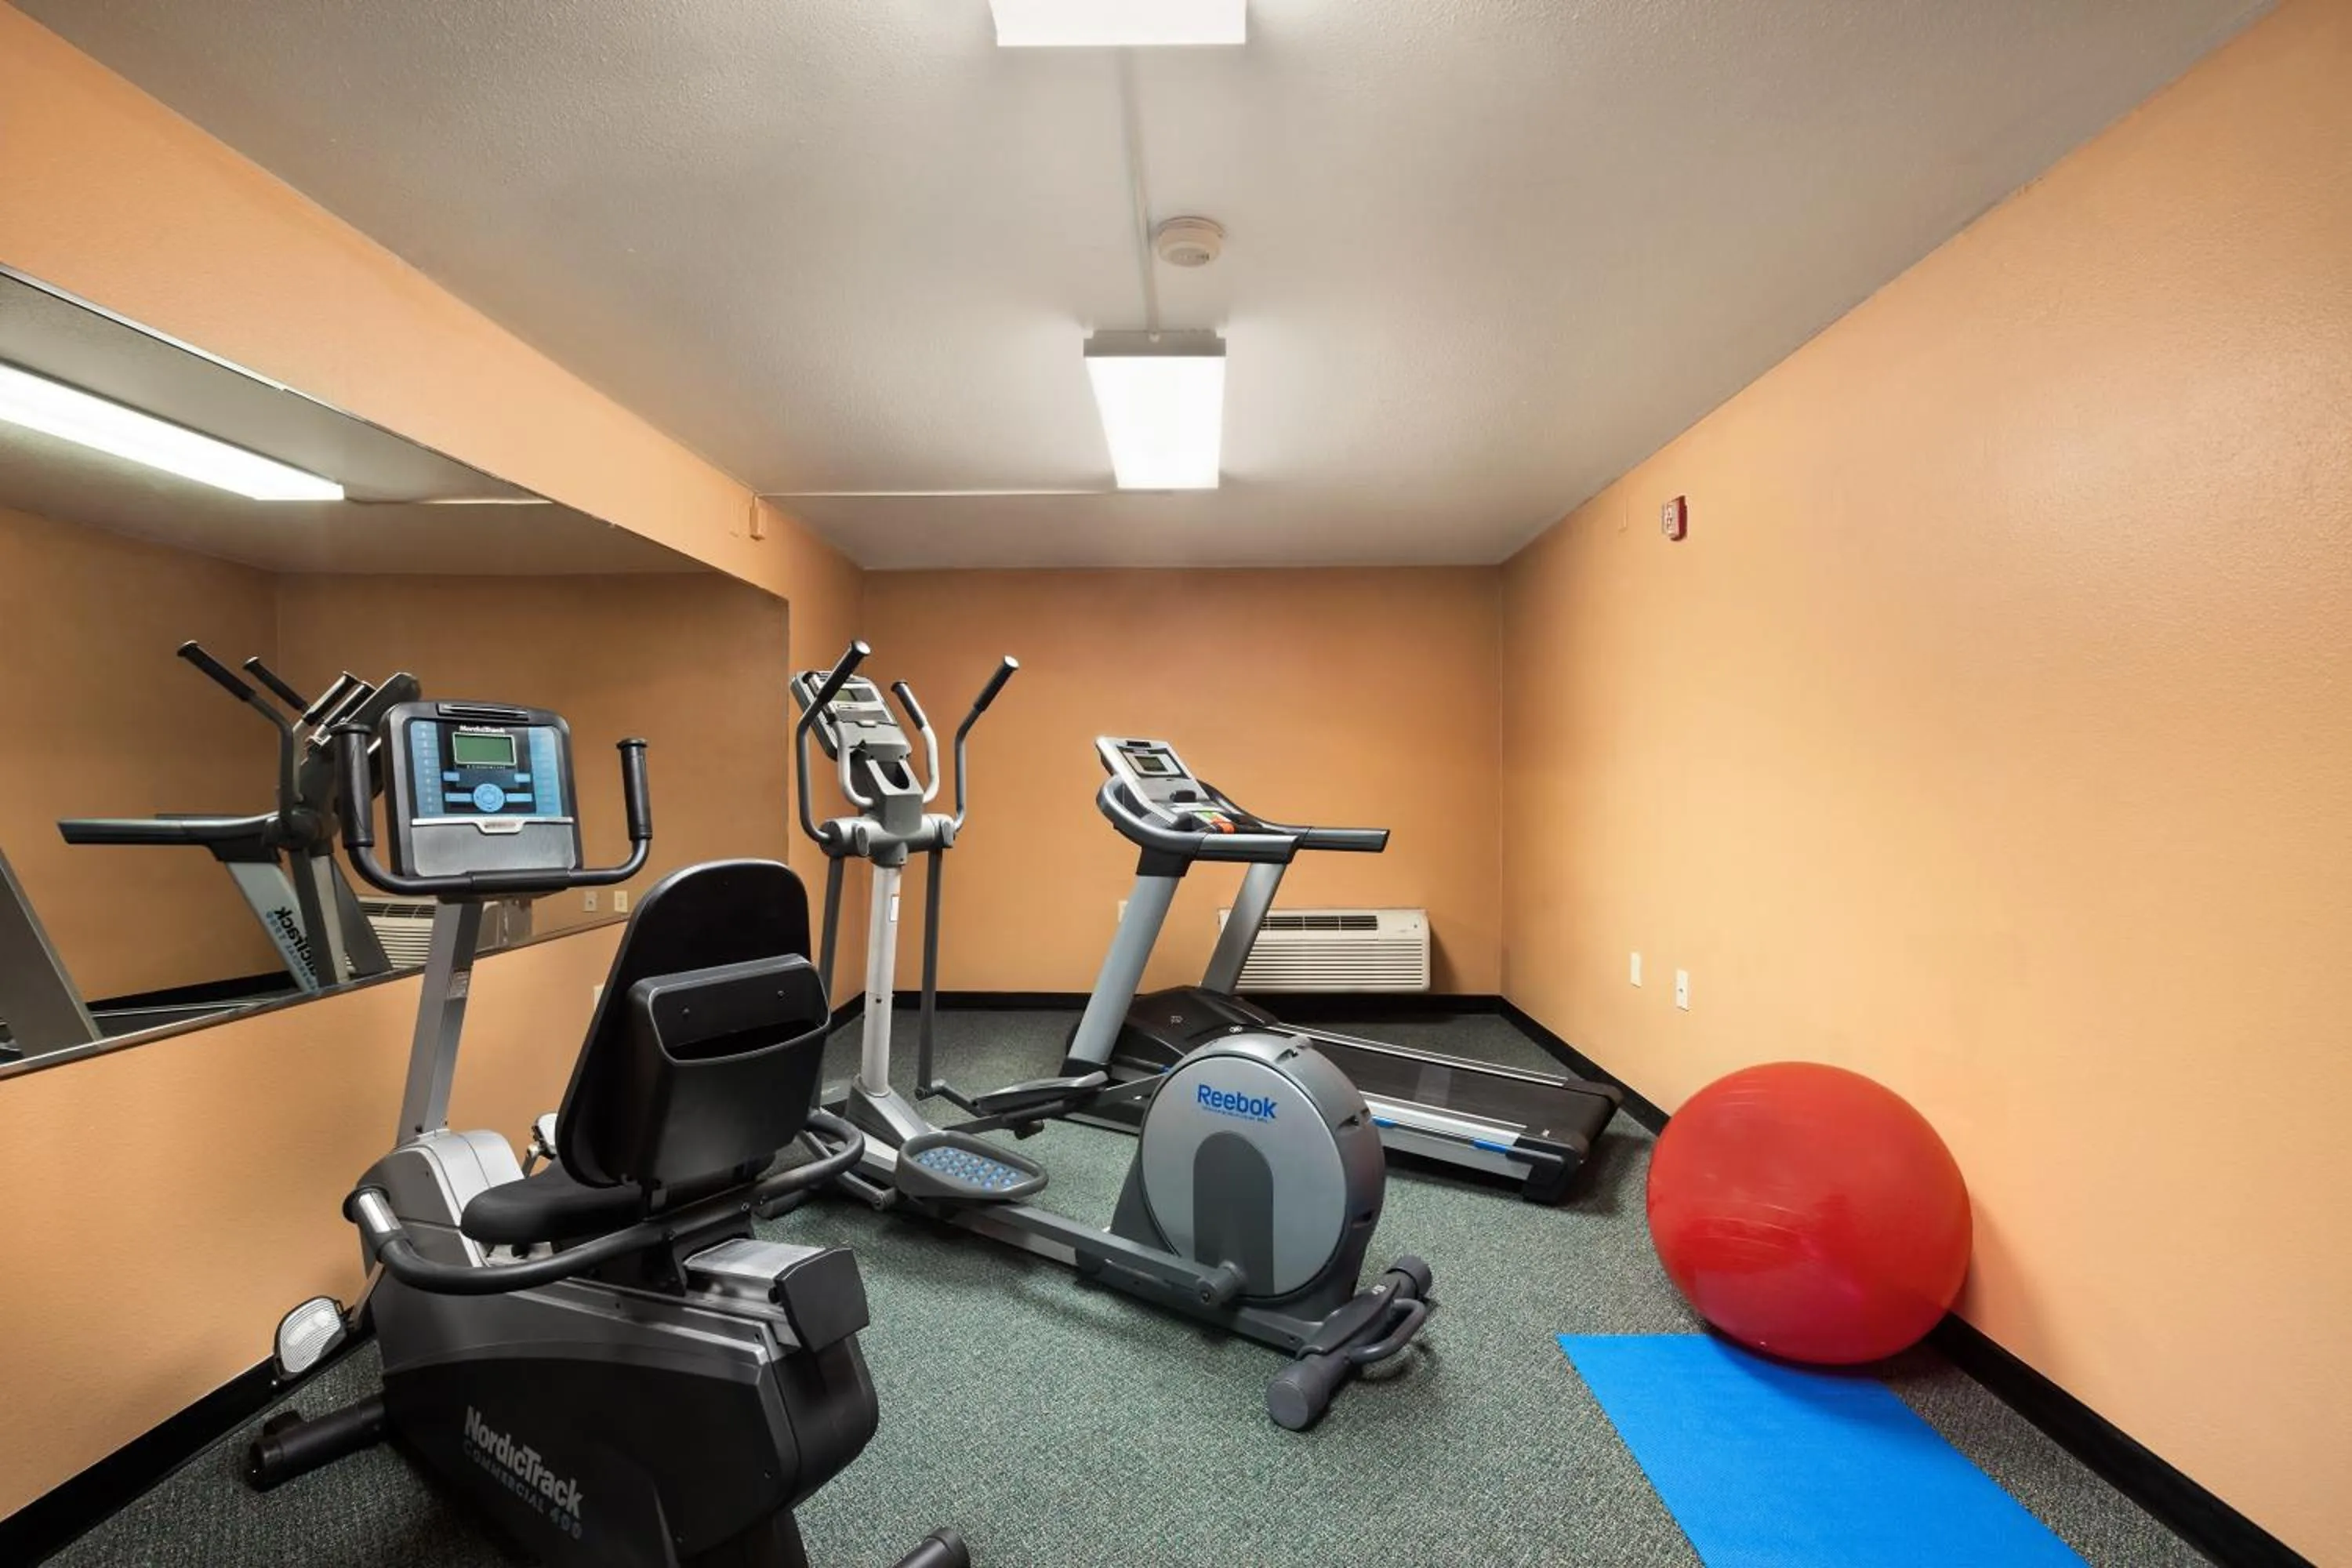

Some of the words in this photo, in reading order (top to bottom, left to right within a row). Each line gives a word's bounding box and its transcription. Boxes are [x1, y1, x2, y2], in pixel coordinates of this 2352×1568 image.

[1197, 1083, 1277, 1119] Reebok
[463, 1439, 544, 1514] COMMERCIAL
[464, 1405, 583, 1519] NordicTrack
